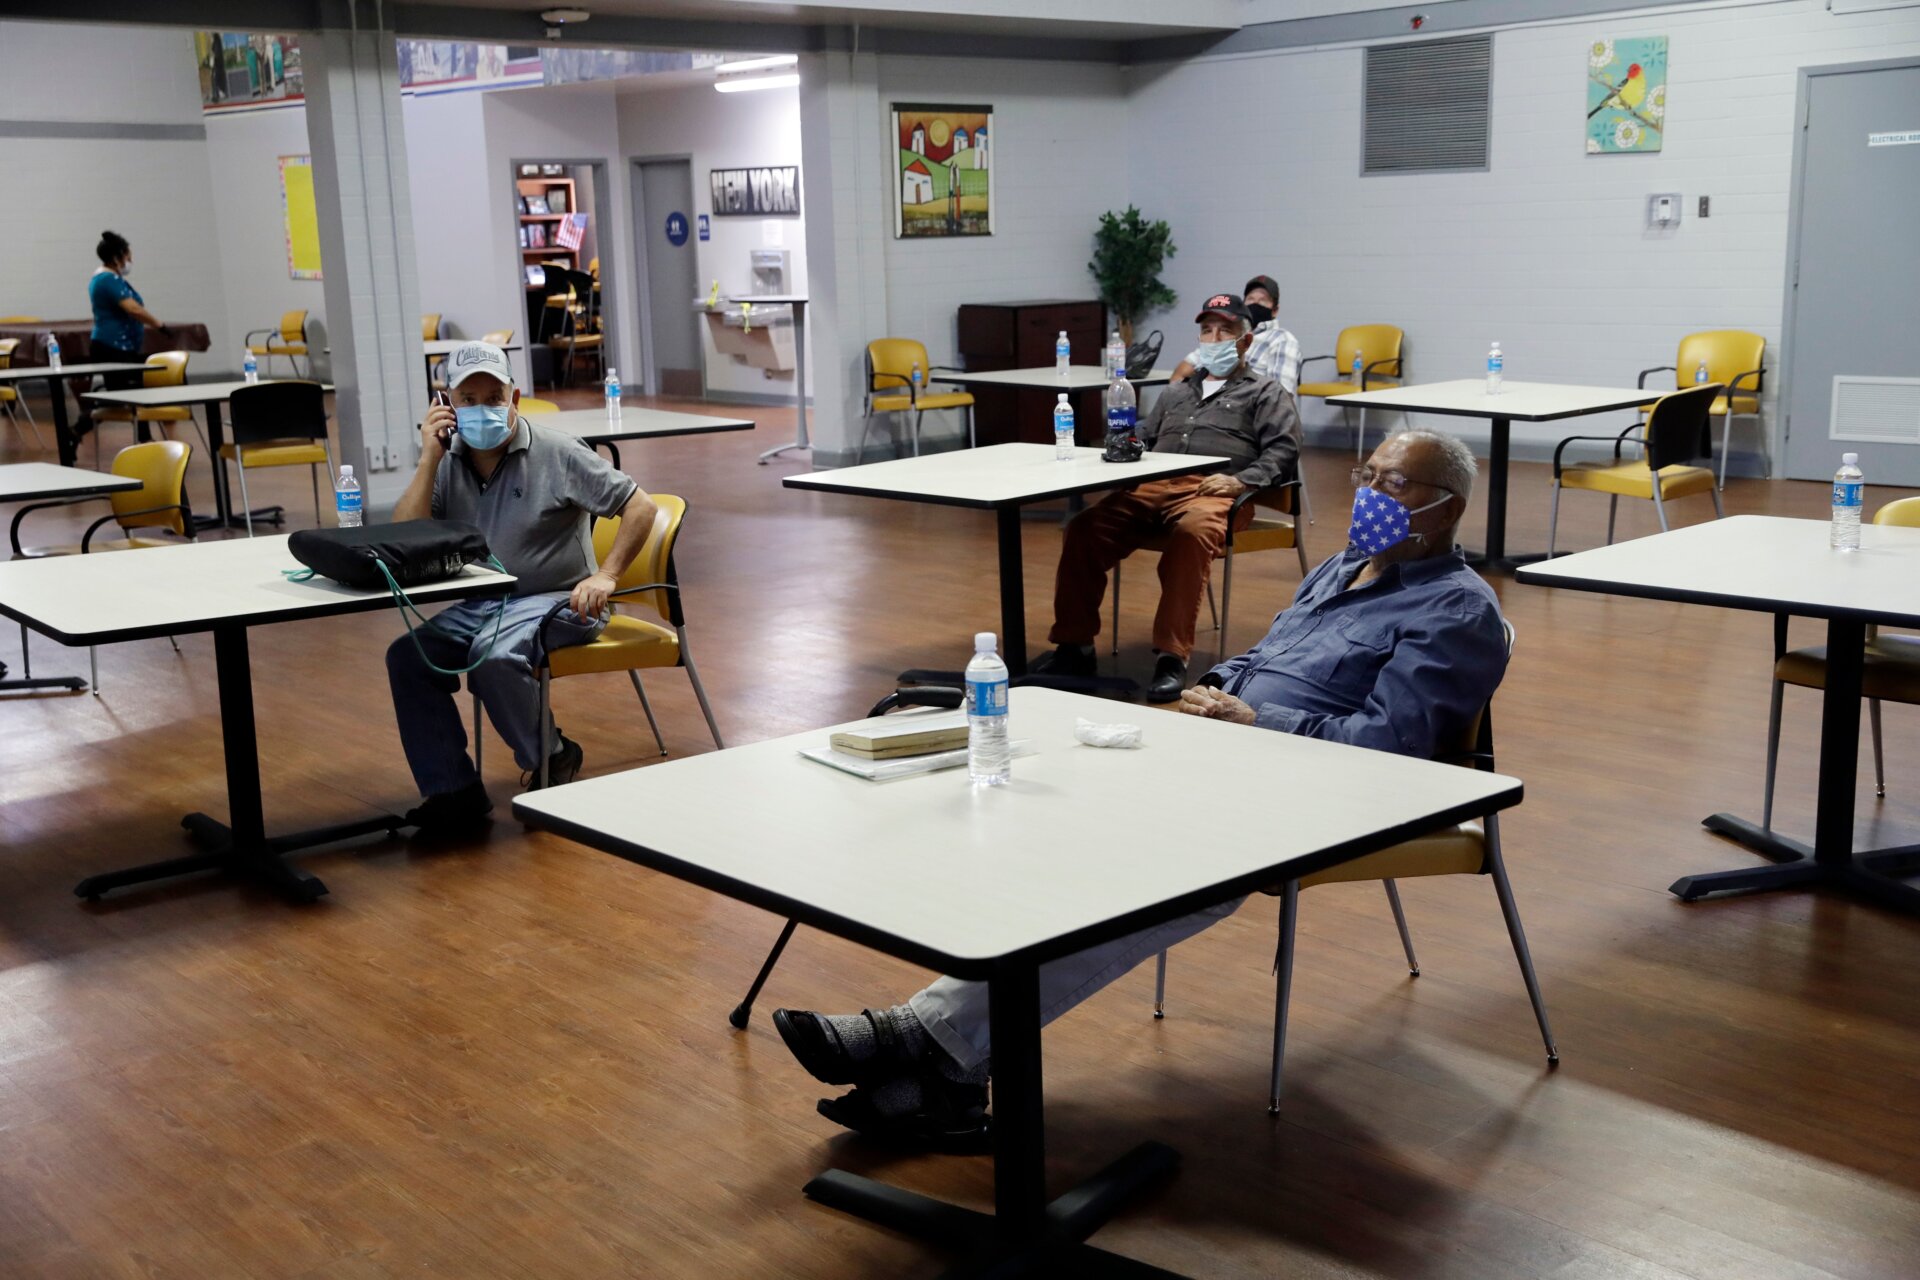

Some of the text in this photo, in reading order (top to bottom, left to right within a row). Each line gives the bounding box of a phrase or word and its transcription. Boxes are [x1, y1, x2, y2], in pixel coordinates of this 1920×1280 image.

[1872, 134, 1920, 143] ELECTRICAL ROO
[711, 167, 798, 213] NEW YORK
[456, 346, 500, 366] California
